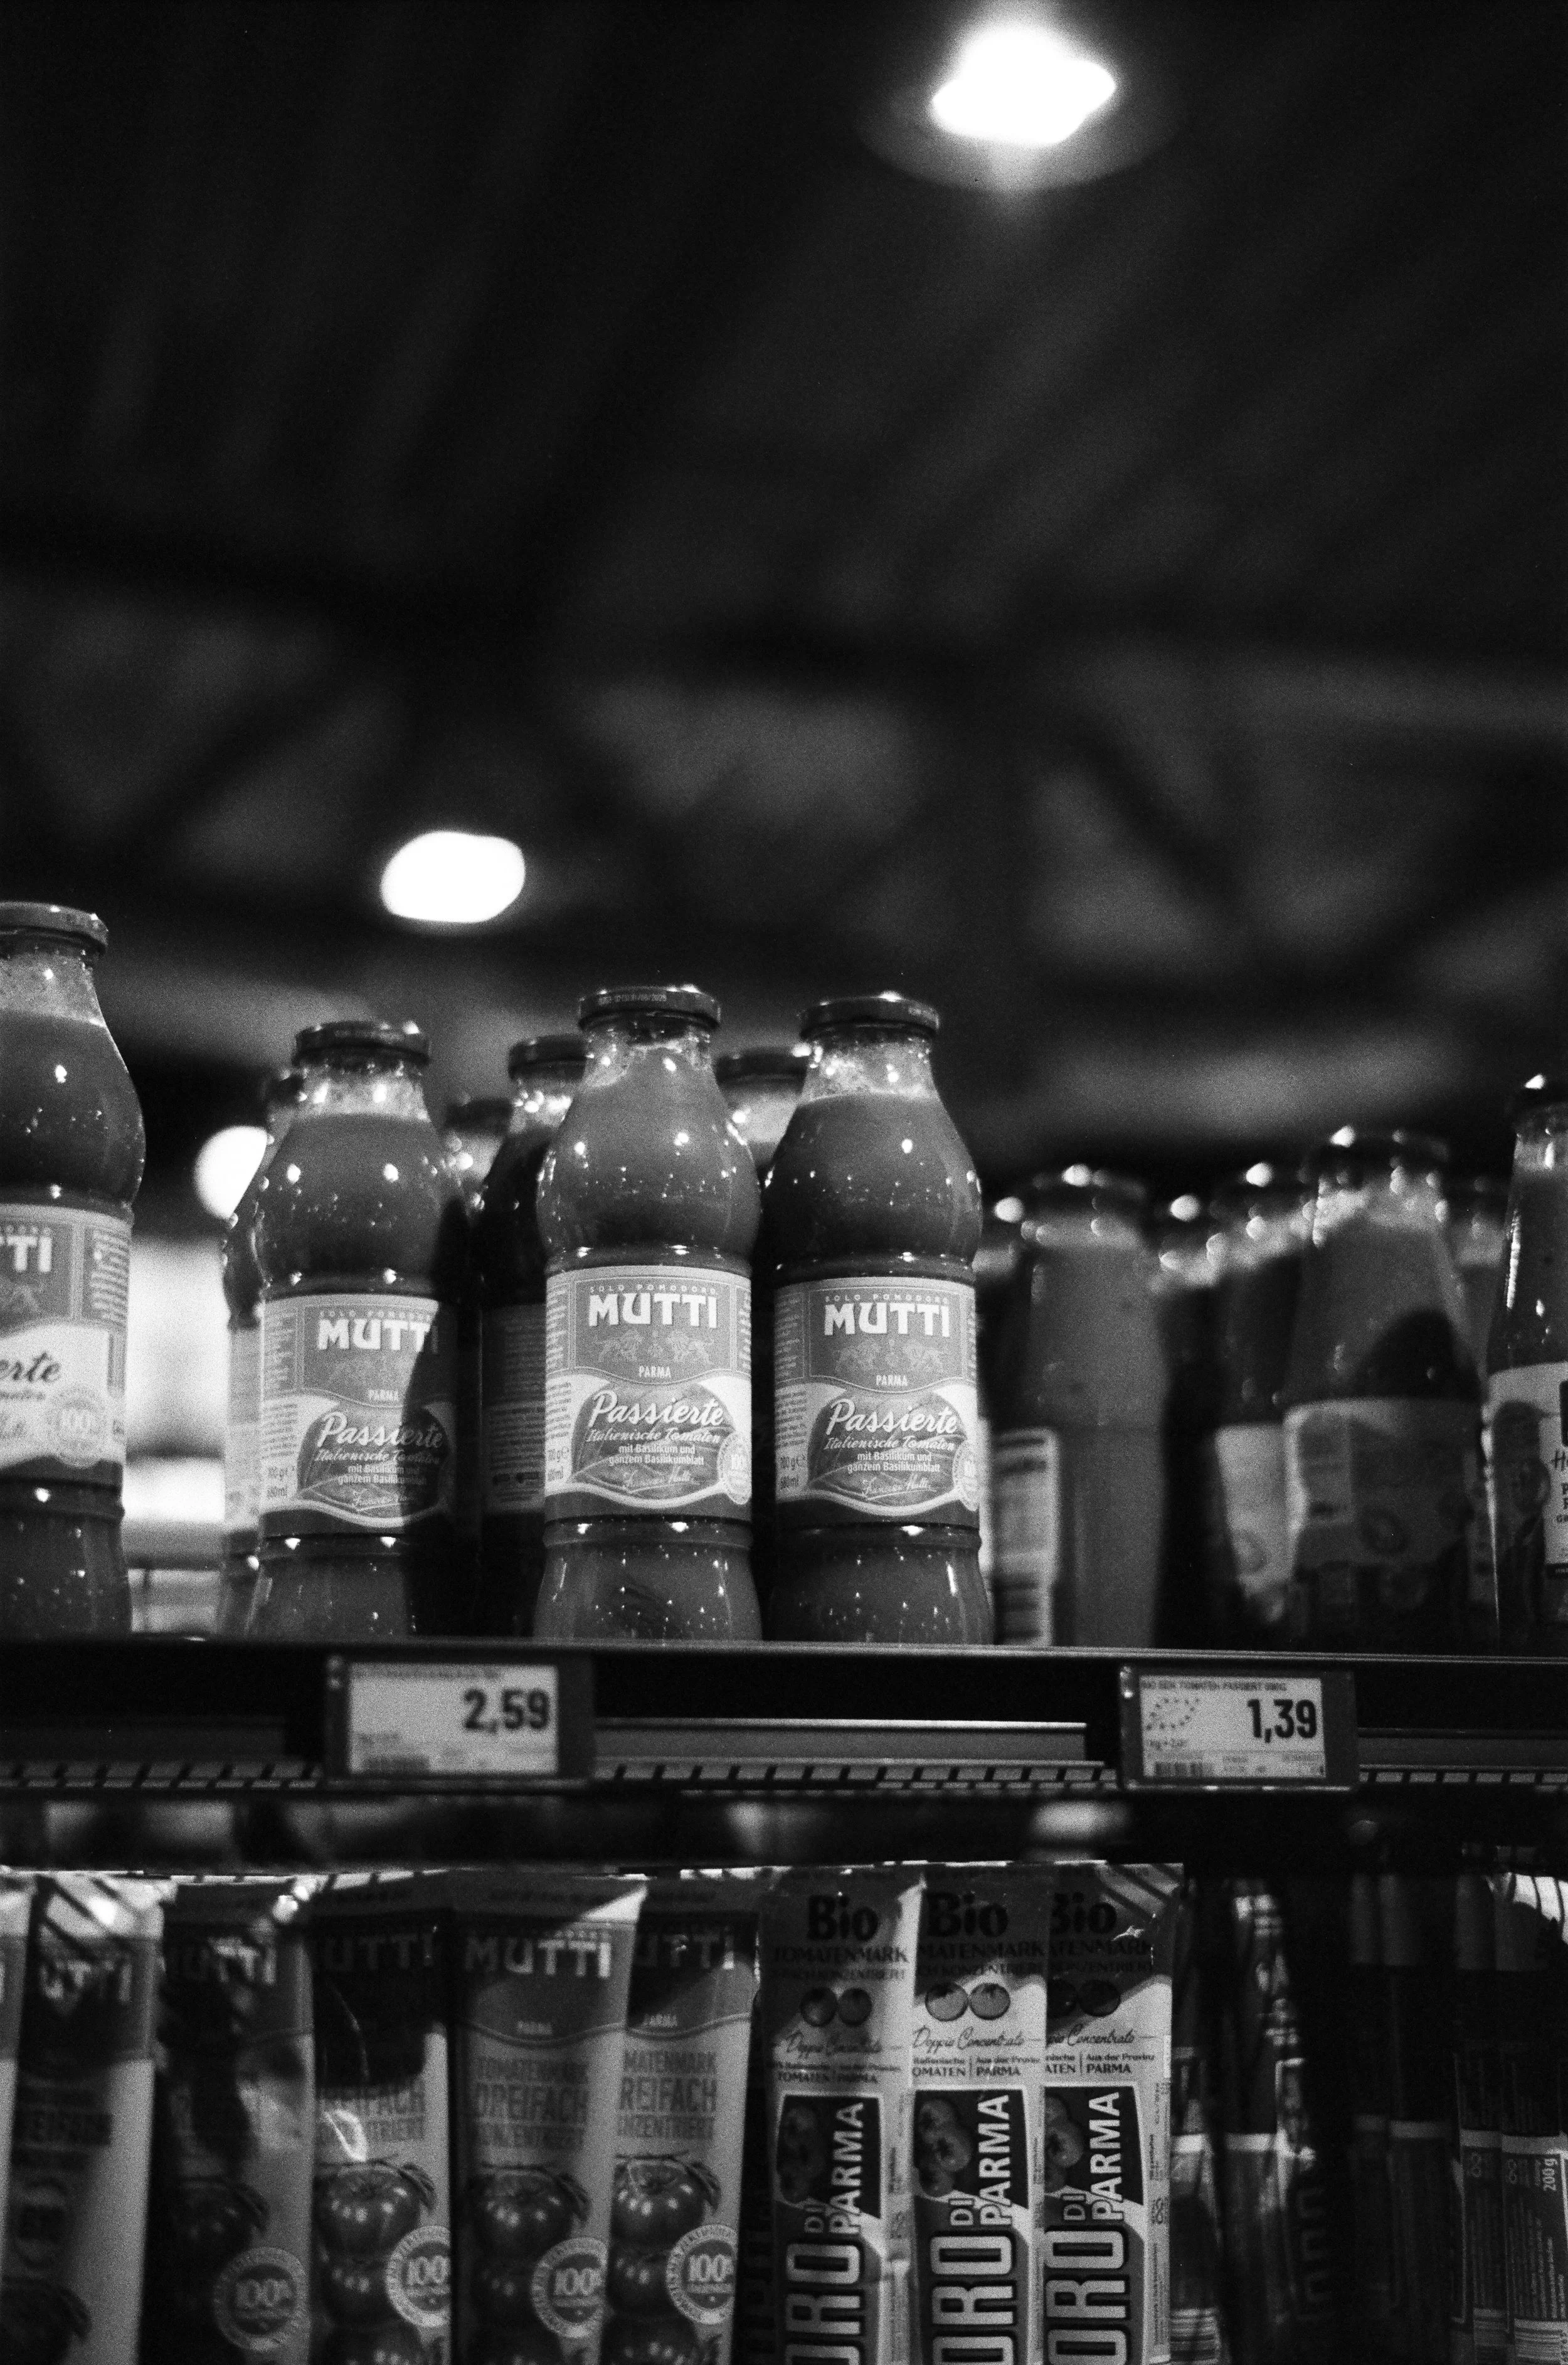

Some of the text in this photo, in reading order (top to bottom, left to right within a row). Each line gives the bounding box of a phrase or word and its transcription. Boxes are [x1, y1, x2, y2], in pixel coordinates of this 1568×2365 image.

[590, 1284, 716, 1295] SOLO POMODORO
[825, 1294, 860, 1303] SOLO
[588, 1292, 718, 1329] MUTTI
[824, 1302, 950, 1338] MUTTI
[317, 1319, 439, 1355] MUTTI
[638, 1365, 672, 1378] PARMA
[876, 1374, 908, 1387] PARMA
[588, 1389, 725, 1427] Passierte
[825, 1398, 958, 1435] Passierte
[316, 1411, 443, 1448] Passierte
[585, 1425, 661, 1443] Italienische
[824, 1435, 956, 1451] Italienische Tomaten
[618, 1443, 696, 1455] mit Basilikum und
[857, 1451, 932, 1462] mit Basilikum und
[882, 1461, 941, 1473] Basilikumblatt
[463, 1689, 550, 1735] 2,59
[1247, 1699, 1318, 1745] 1,39
[807, 1894, 879, 1942] Bio
[926, 1891, 1009, 1938] Bio
[465, 1935, 610, 1979] MUTTI
[774, 1946, 909, 1964] TOMATENMARK
[1067, 2023, 1136, 2047] Concentrato
[976, 2066, 1021, 2077] PARMA
[1086, 2053, 1155, 2062] Aus der Provinz
[1086, 2063, 1131, 2075] PARMA
[829, 2101, 864, 2236] PARMA
[977, 2094, 1012, 2226] PARMA
[1088, 2091, 1125, 2222] PARMA
[803, 2203, 826, 2234] DI
[950, 2198, 976, 2227] DI
[1062, 2192, 1086, 2223] DI
[1045, 2230, 1126, 2365] ORO
